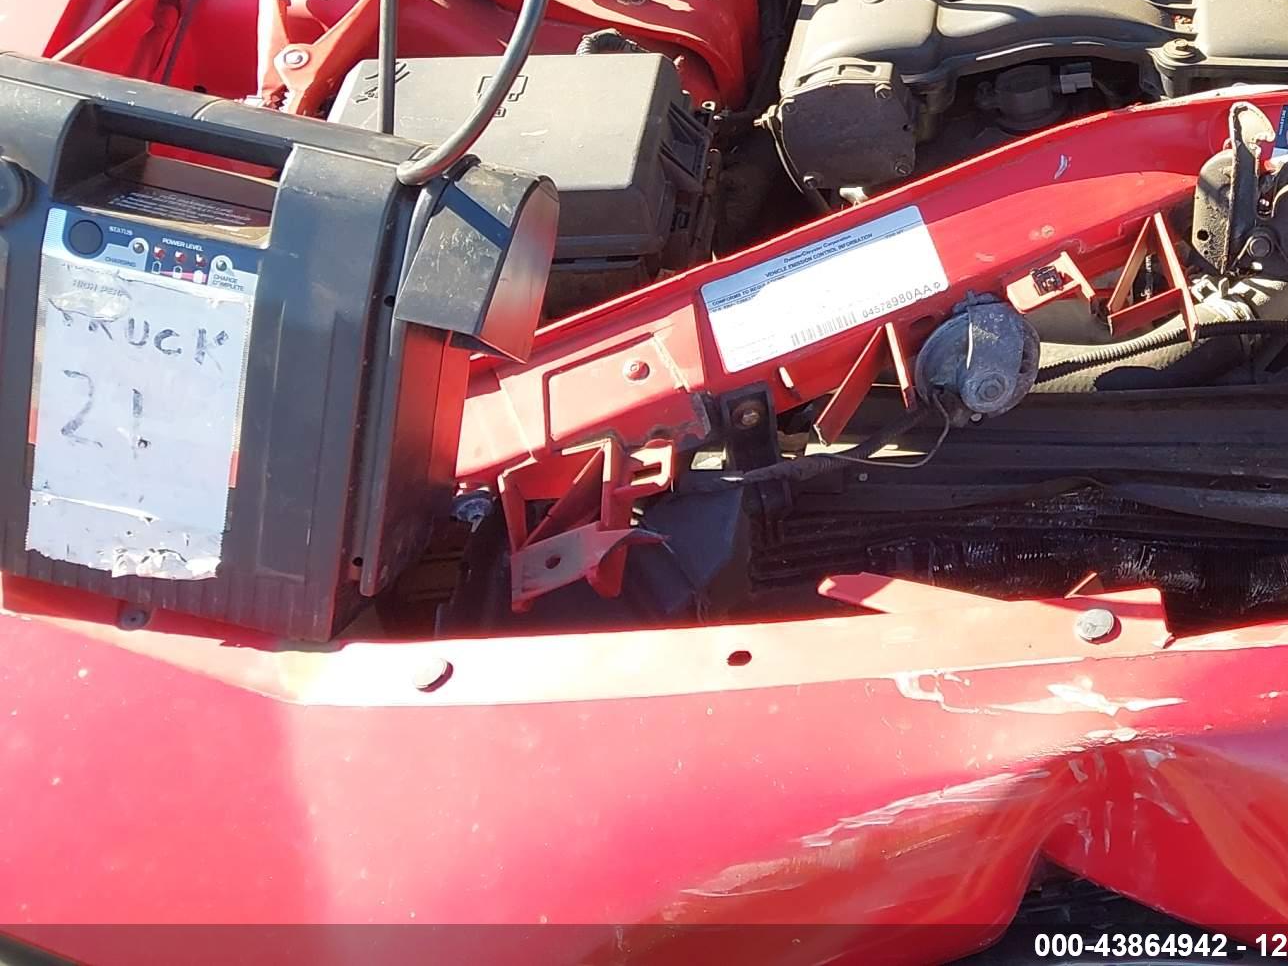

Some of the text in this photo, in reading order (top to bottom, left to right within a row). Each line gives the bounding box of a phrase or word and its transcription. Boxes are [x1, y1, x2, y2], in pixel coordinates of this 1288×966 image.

[109, 225, 133, 236] STATUS
[162, 237, 204, 252] POWER LEVEL
[765, 264, 788, 278] VEHICLE
[788, 255, 813, 270] EMISSION
[812, 246, 838, 260] CONTROL
[838, 233, 873, 250] INFORMATION
[213, 273, 238, 284] CHARGE
[712, 293, 741, 306] CONFORMS
[862, 283, 933, 318] 04578980AA
